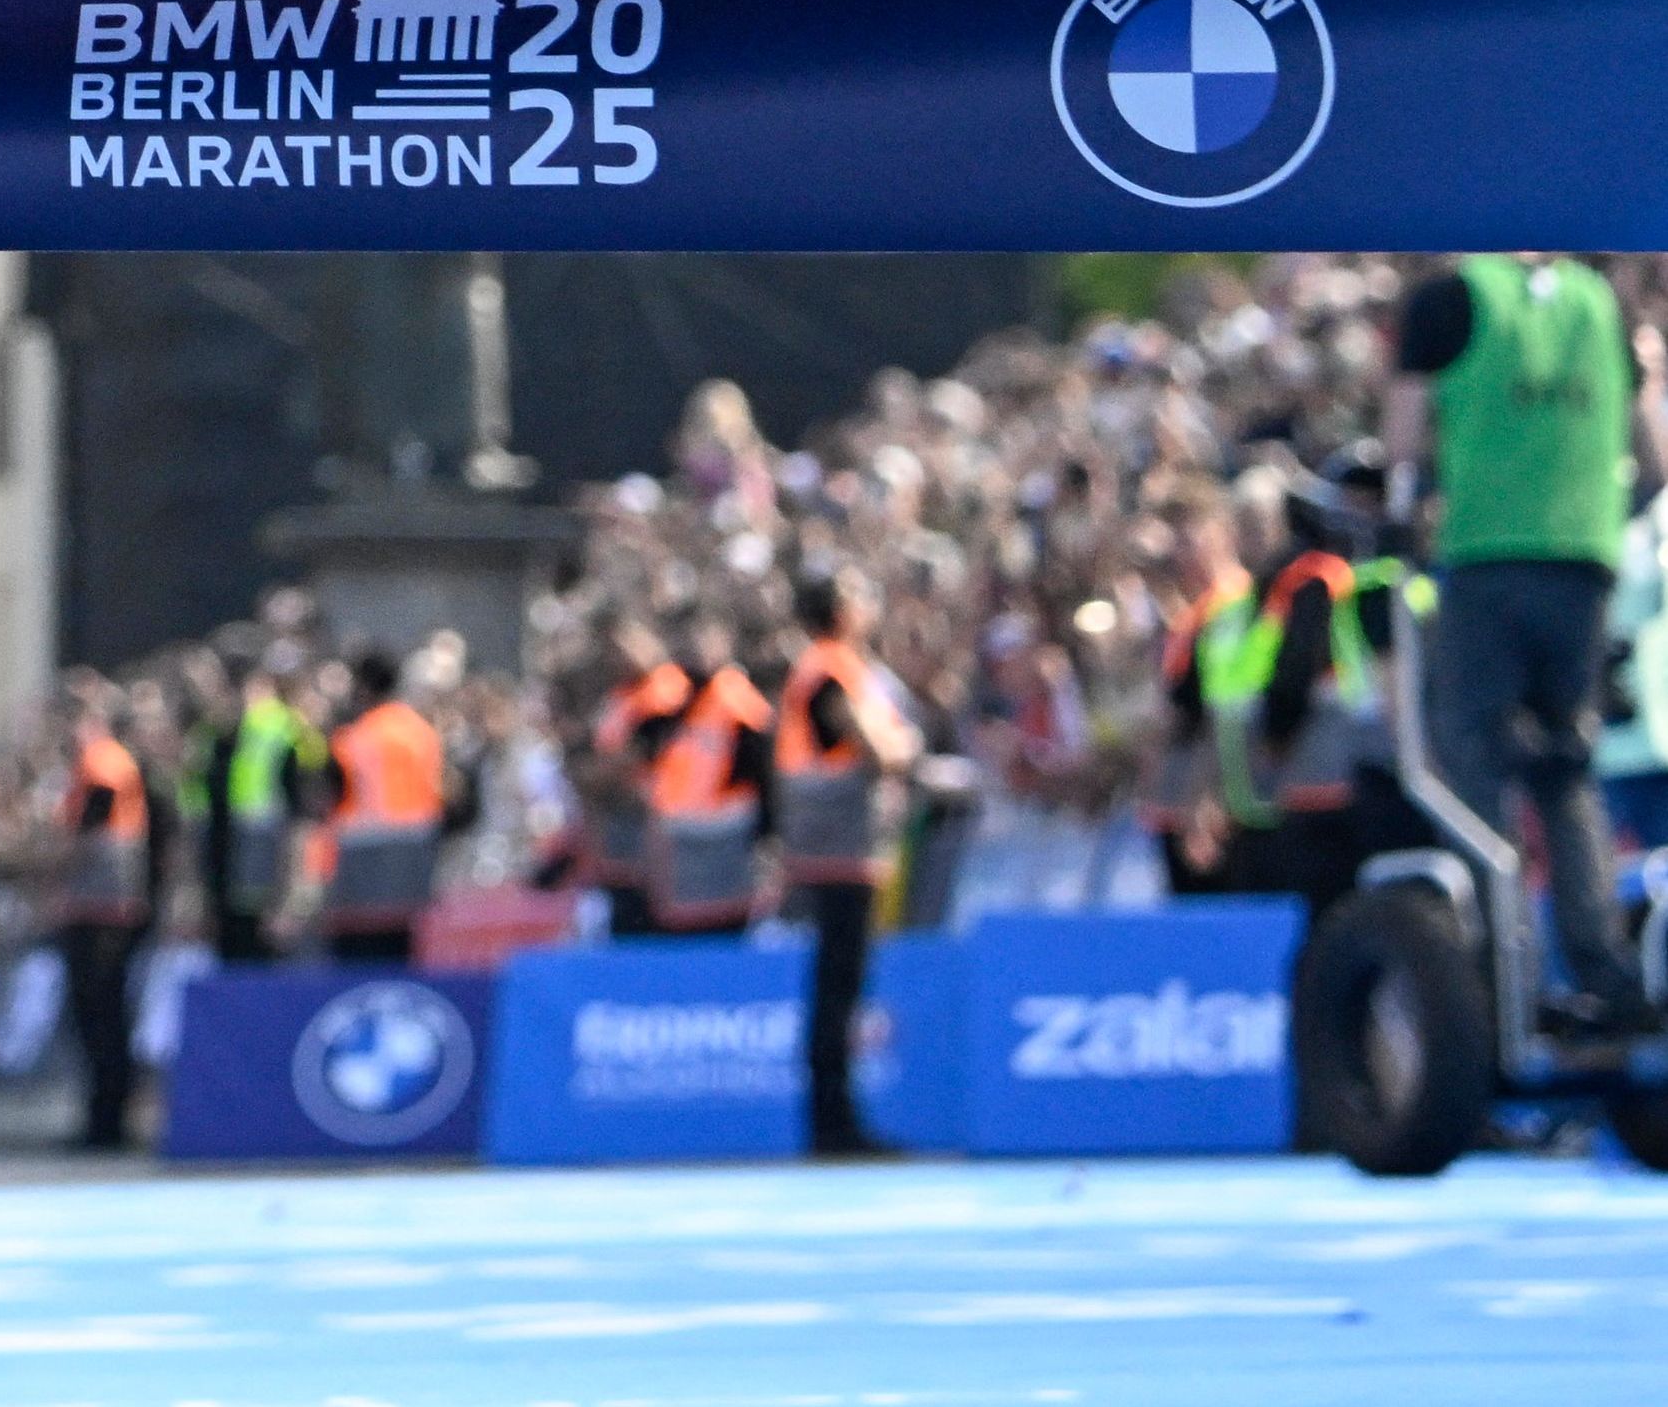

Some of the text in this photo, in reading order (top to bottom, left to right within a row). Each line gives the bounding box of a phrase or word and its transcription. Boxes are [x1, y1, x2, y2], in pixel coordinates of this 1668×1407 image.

[69, 70, 334, 120] BERLIN
[69, 135, 492, 187] MARATHON
[508, 87, 657, 186] 25
